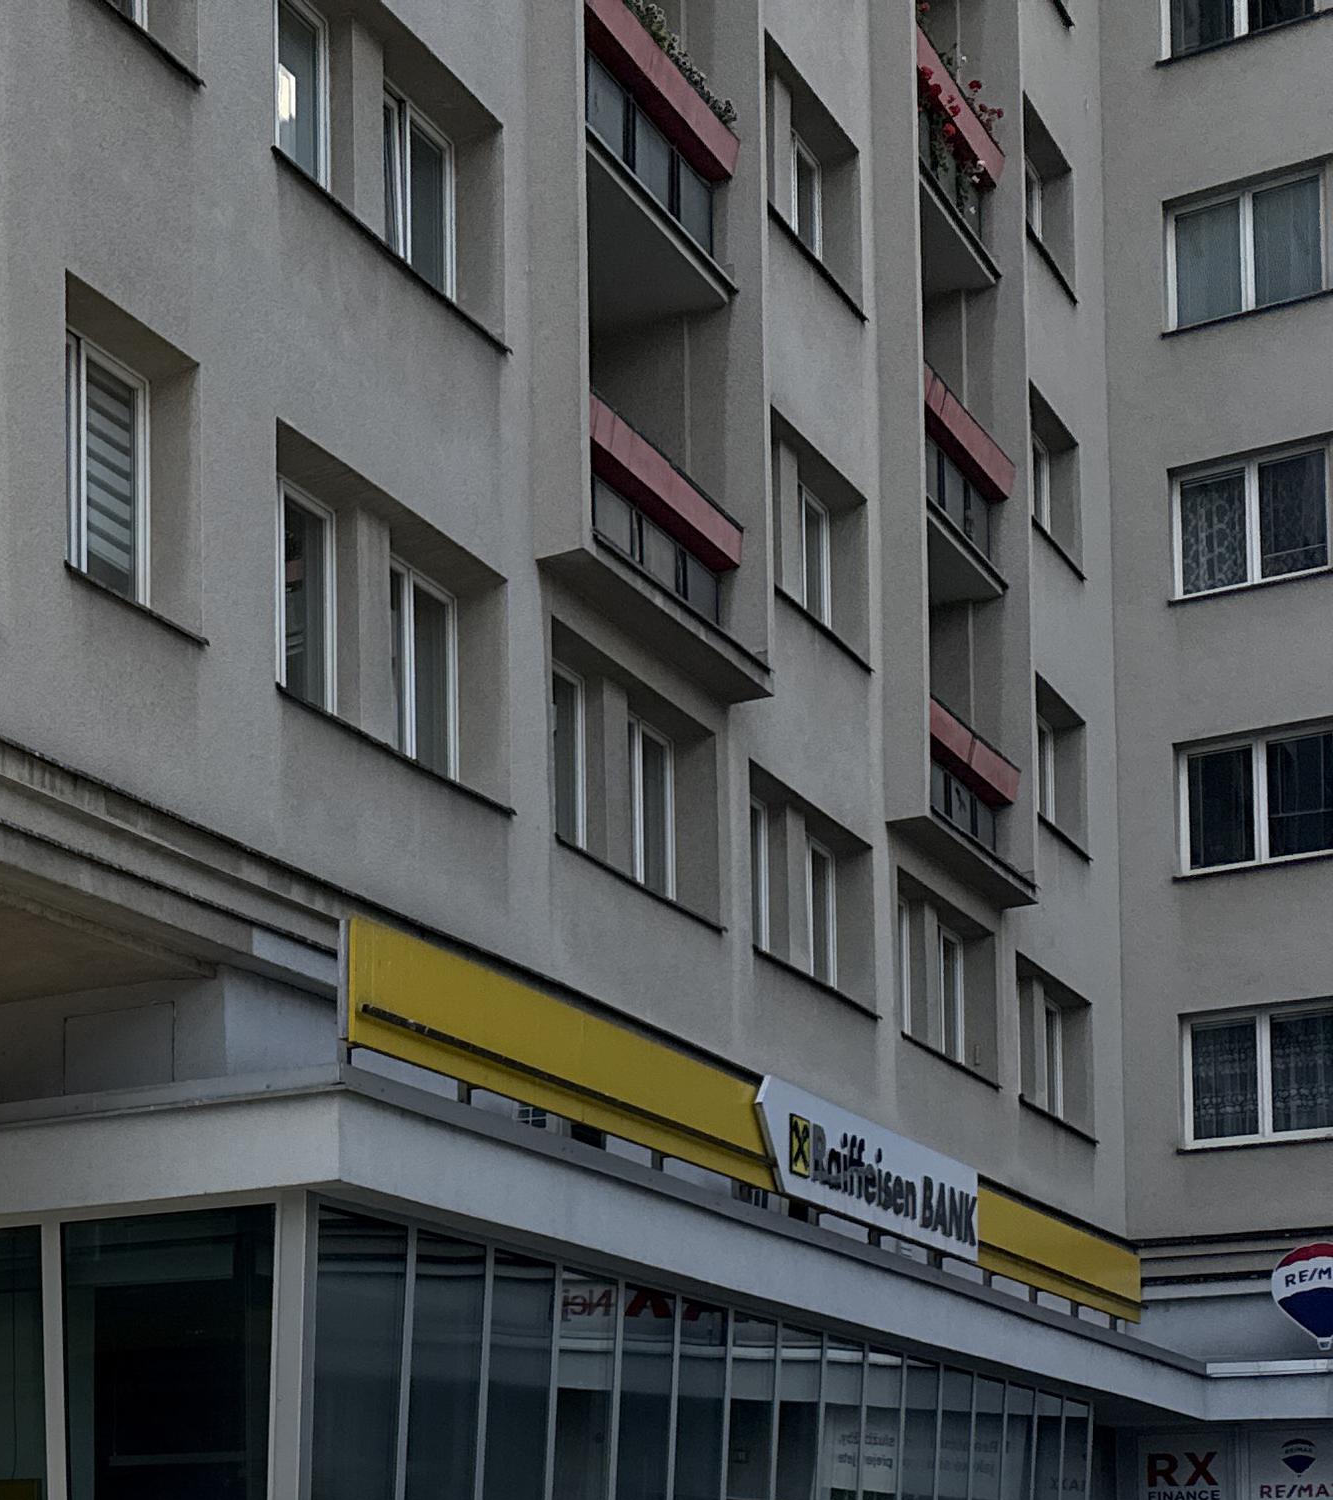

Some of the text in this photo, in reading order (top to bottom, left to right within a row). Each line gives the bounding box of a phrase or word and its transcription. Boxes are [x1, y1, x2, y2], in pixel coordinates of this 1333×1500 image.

[811, 1123, 978, 1247] Raiffeisen BANK
[1147, 1451, 1219, 1487] RX
[1259, 1484, 1333, 1498] RE/MA
